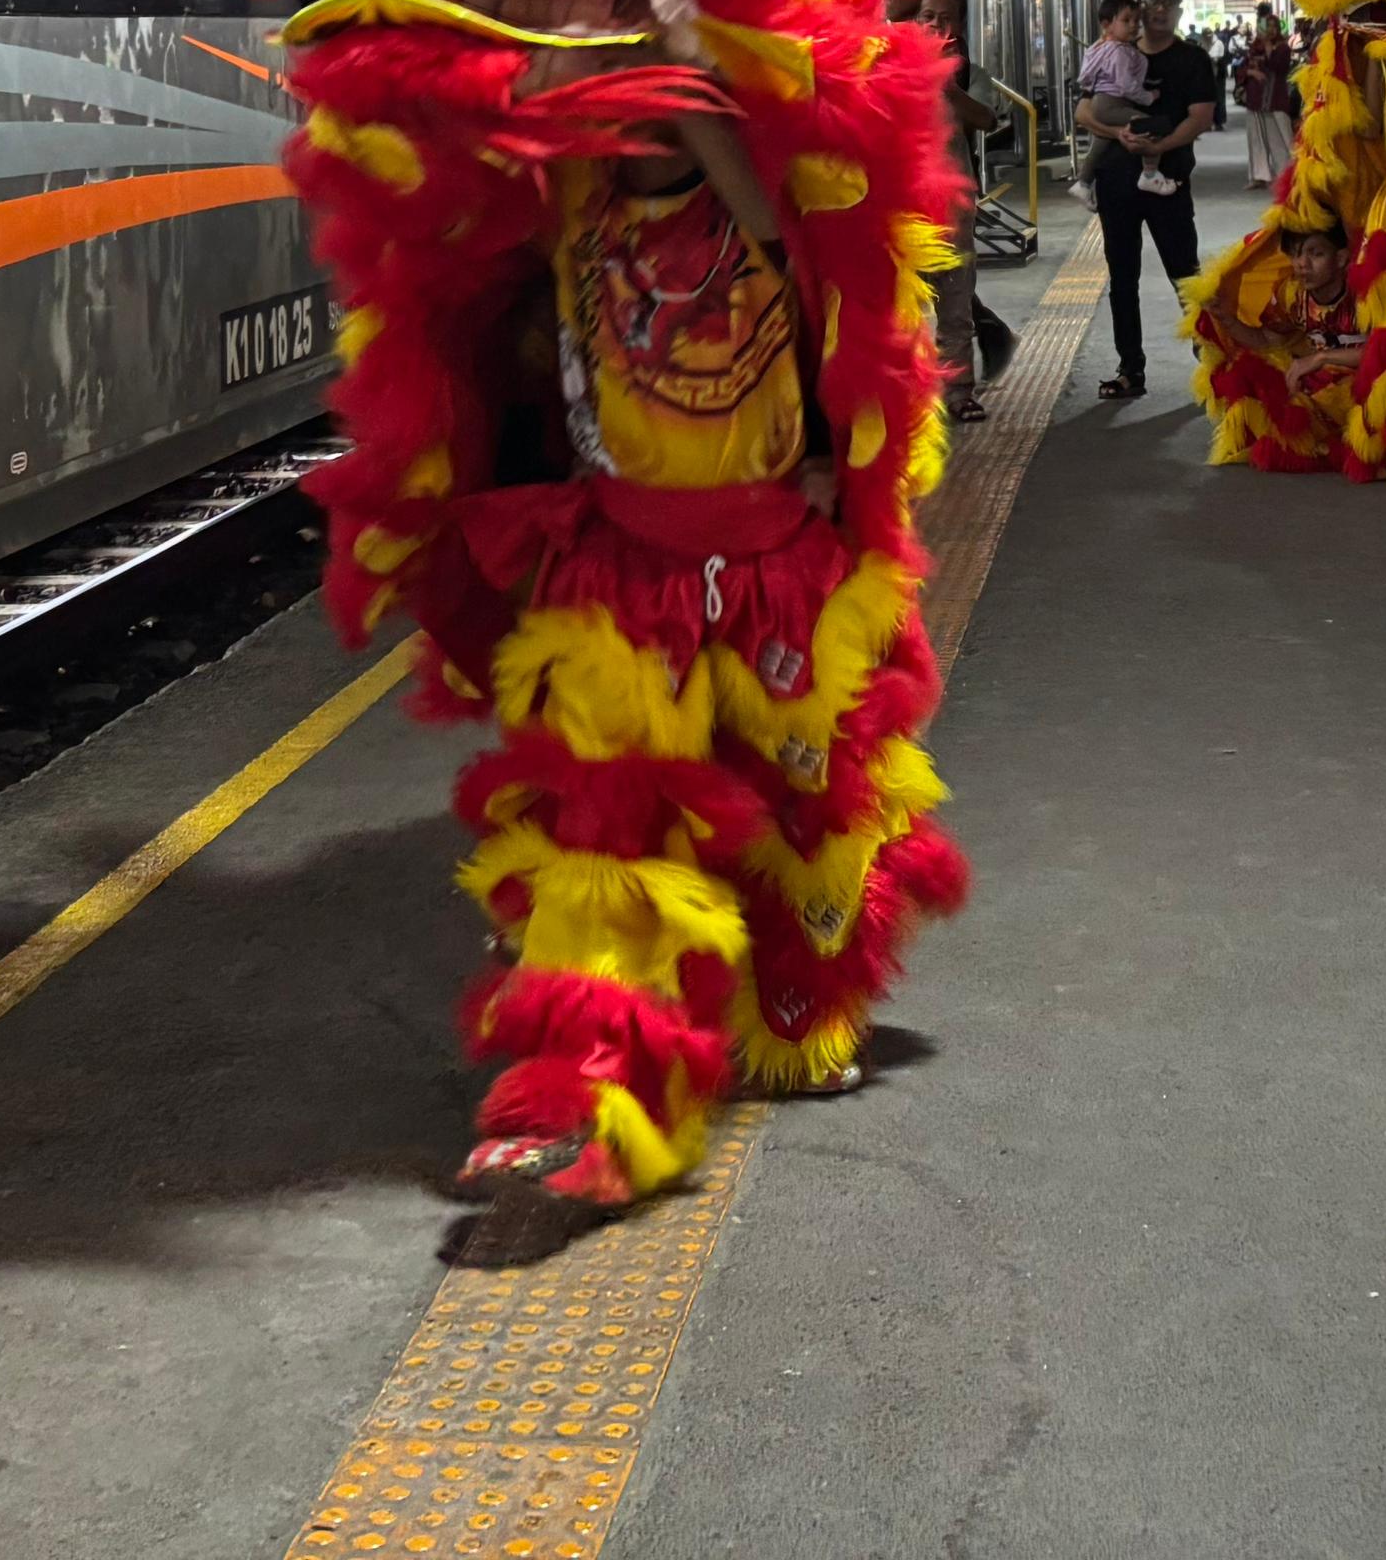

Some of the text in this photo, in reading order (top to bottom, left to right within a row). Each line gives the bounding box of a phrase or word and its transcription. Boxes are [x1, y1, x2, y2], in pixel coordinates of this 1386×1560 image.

[225, 314, 250, 385] K1
[269, 304, 288, 369] 18
[292, 295, 312, 360] 25
